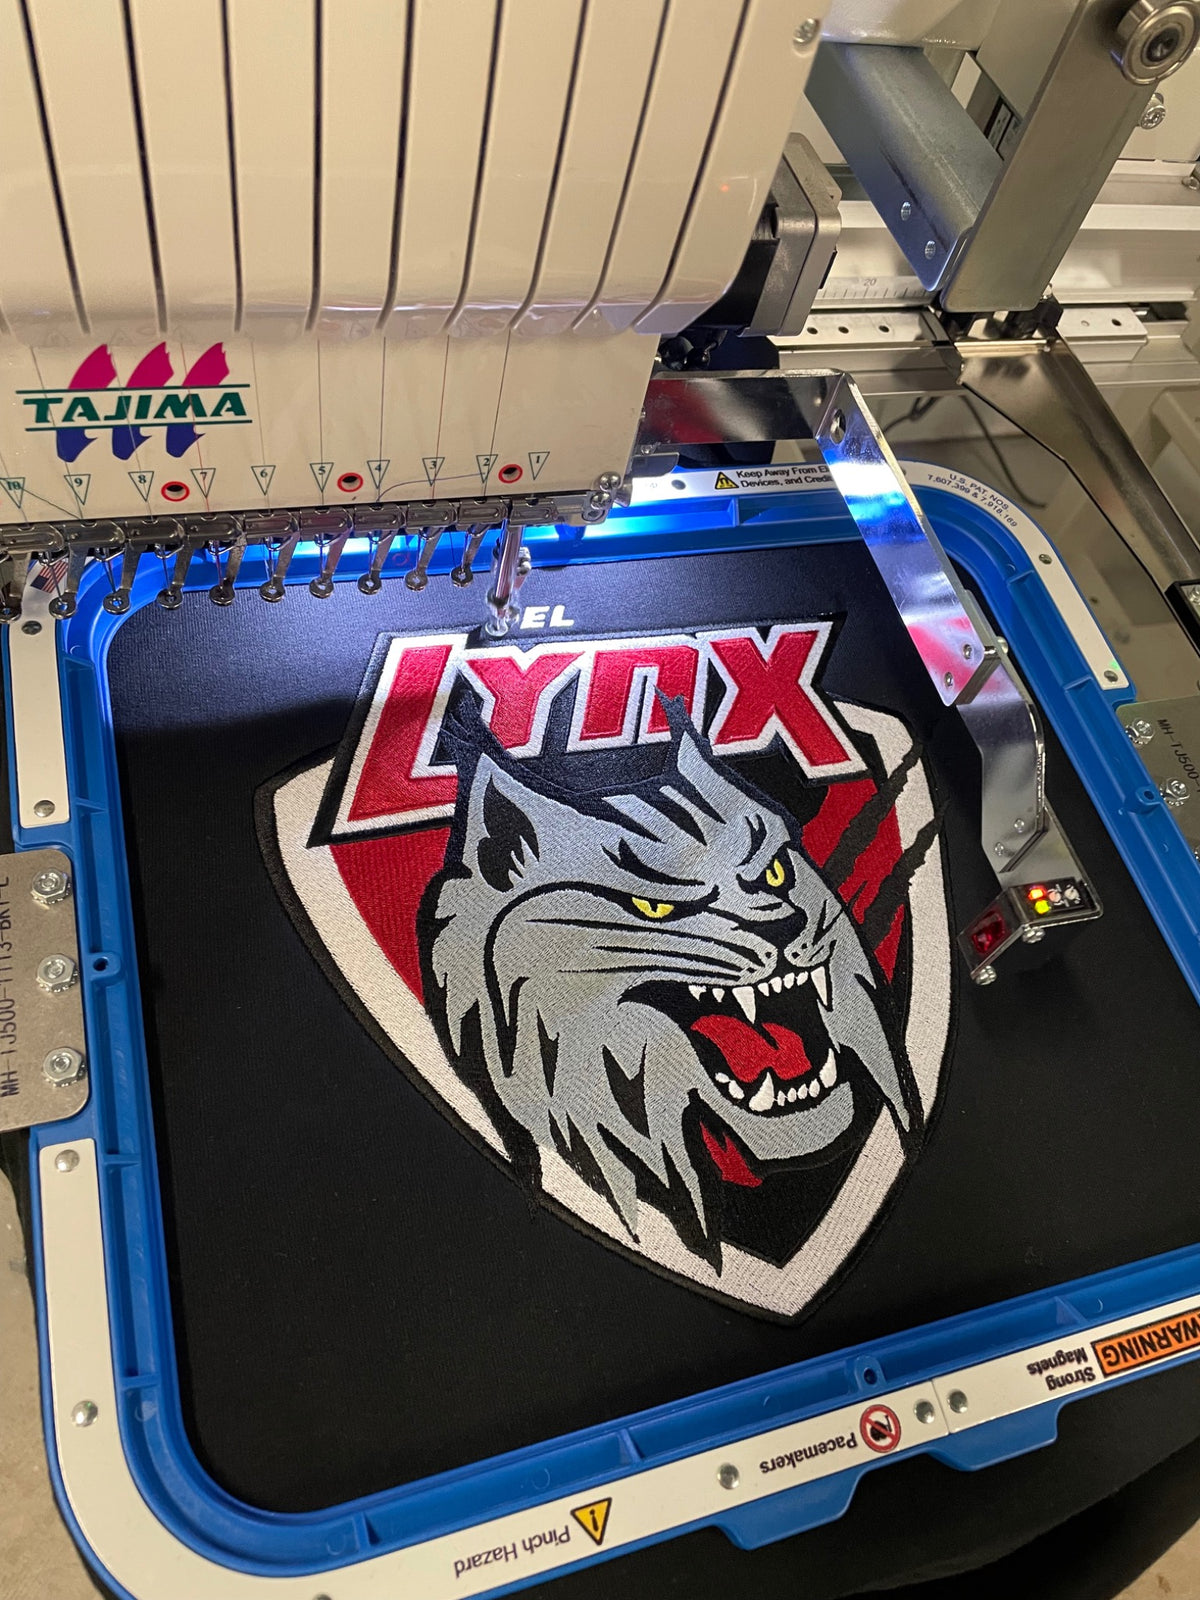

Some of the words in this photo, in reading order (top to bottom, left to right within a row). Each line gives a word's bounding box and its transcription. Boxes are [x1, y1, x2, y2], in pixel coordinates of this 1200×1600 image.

[863, 279, 877, 287] 20
[23, 392, 247, 424] TAJIMA
[74, 477, 83, 487] 9
[137, 474, 147, 484] 8
[200, 471, 208, 482] 7
[260, 467, 268, 478] 6
[318, 465, 326, 476] 5
[374, 463, 382, 473] 4
[429, 460, 437, 470] 3
[483, 457, 491, 467] 2
[535, 454, 541, 464] 1
[736, 470, 763, 479] Keep
[764, 467, 790, 477] Away
[792, 465, 818, 475] From
[740, 479, 783, 488] Devices,
[785, 476, 803, 485] and
[949, 473, 967, 485] U.S.
[970, 482, 988, 497] PAT.
[1102, 1317, 1200, 1366] WARNING
[1027, 1347, 1088, 1375] Magnets
[1046, 1367, 1096, 1391] Strong
[759, 1432, 858, 1473] Pacemakers
[522, 1525, 571, 1554] Pinch
[454, 1543, 518, 1578] Hazard
